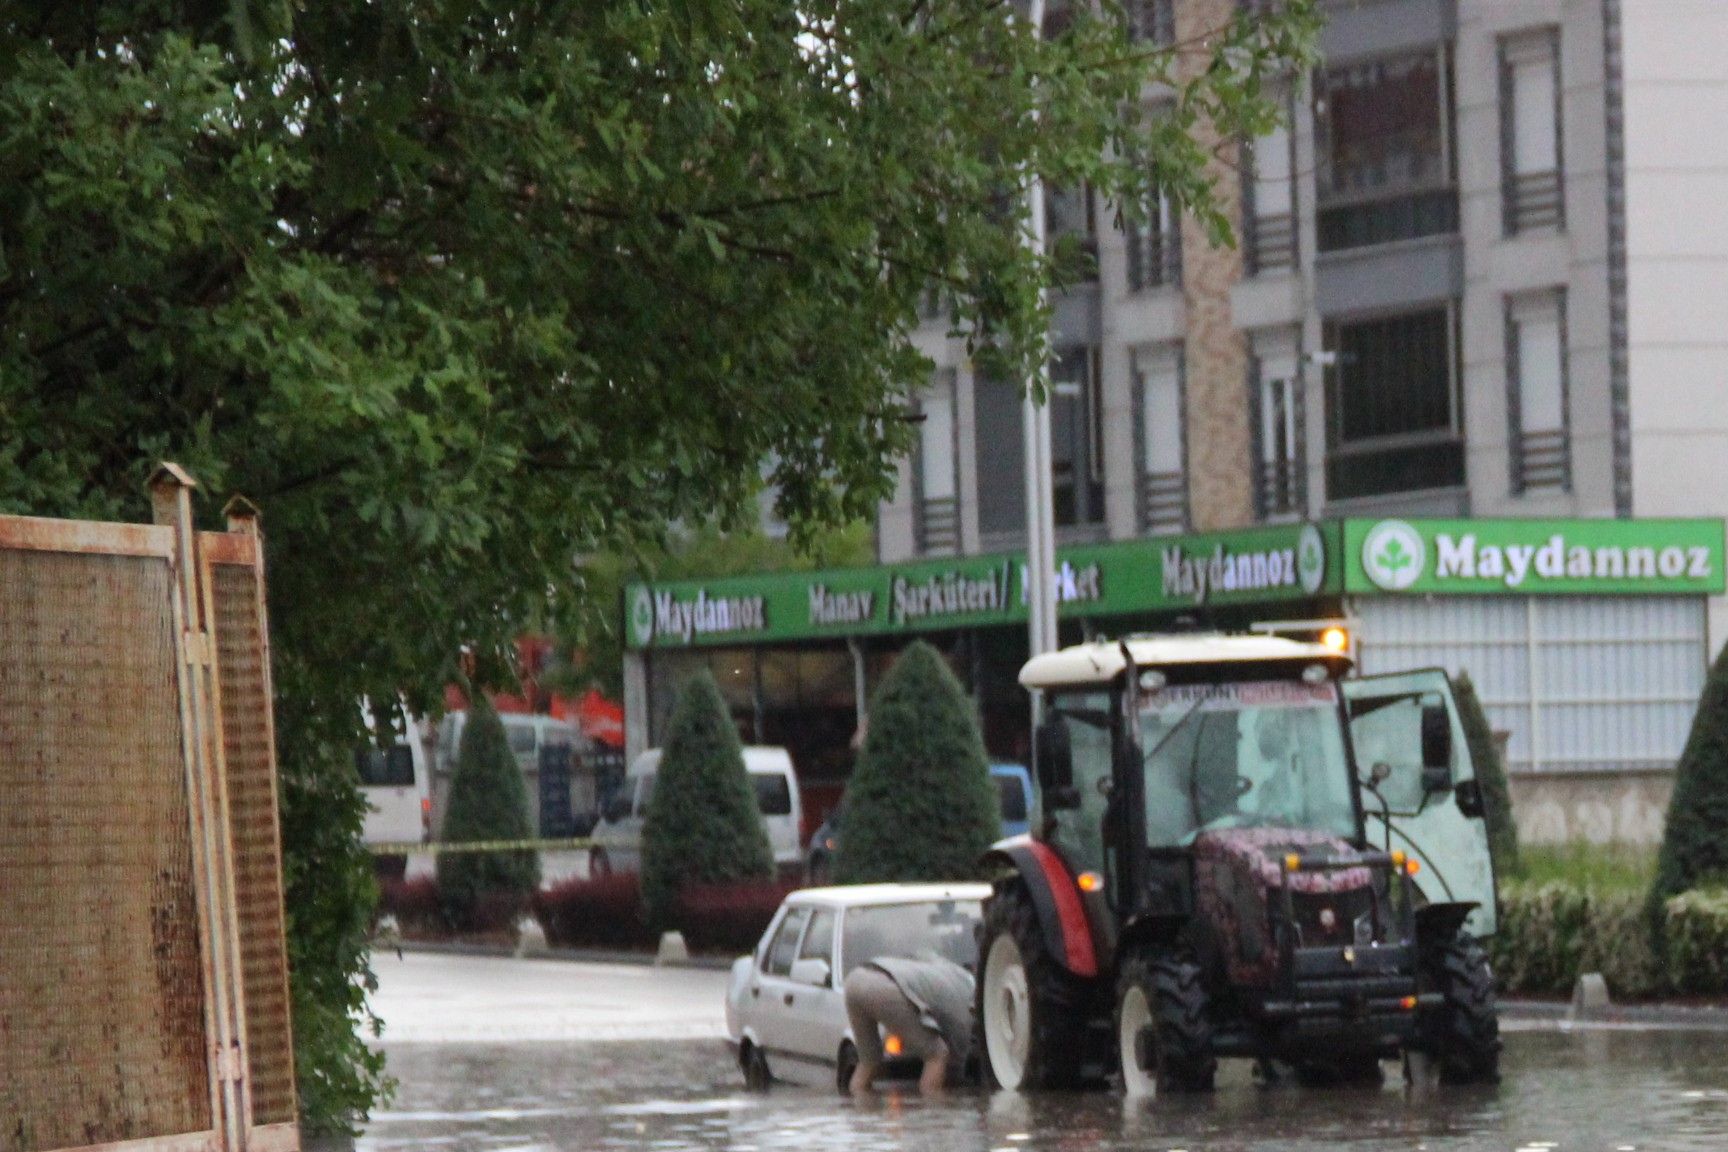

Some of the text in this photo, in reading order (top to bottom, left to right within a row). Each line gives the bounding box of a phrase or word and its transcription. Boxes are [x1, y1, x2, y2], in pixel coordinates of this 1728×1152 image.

[1162, 544, 1295, 602] Maydannoz
[1436, 534, 1711, 587] Maydannoz
[655, 587, 763, 644] Maydannoz
[809, 583, 873, 624] Manav
[1020, 561, 1098, 604] Mrket
